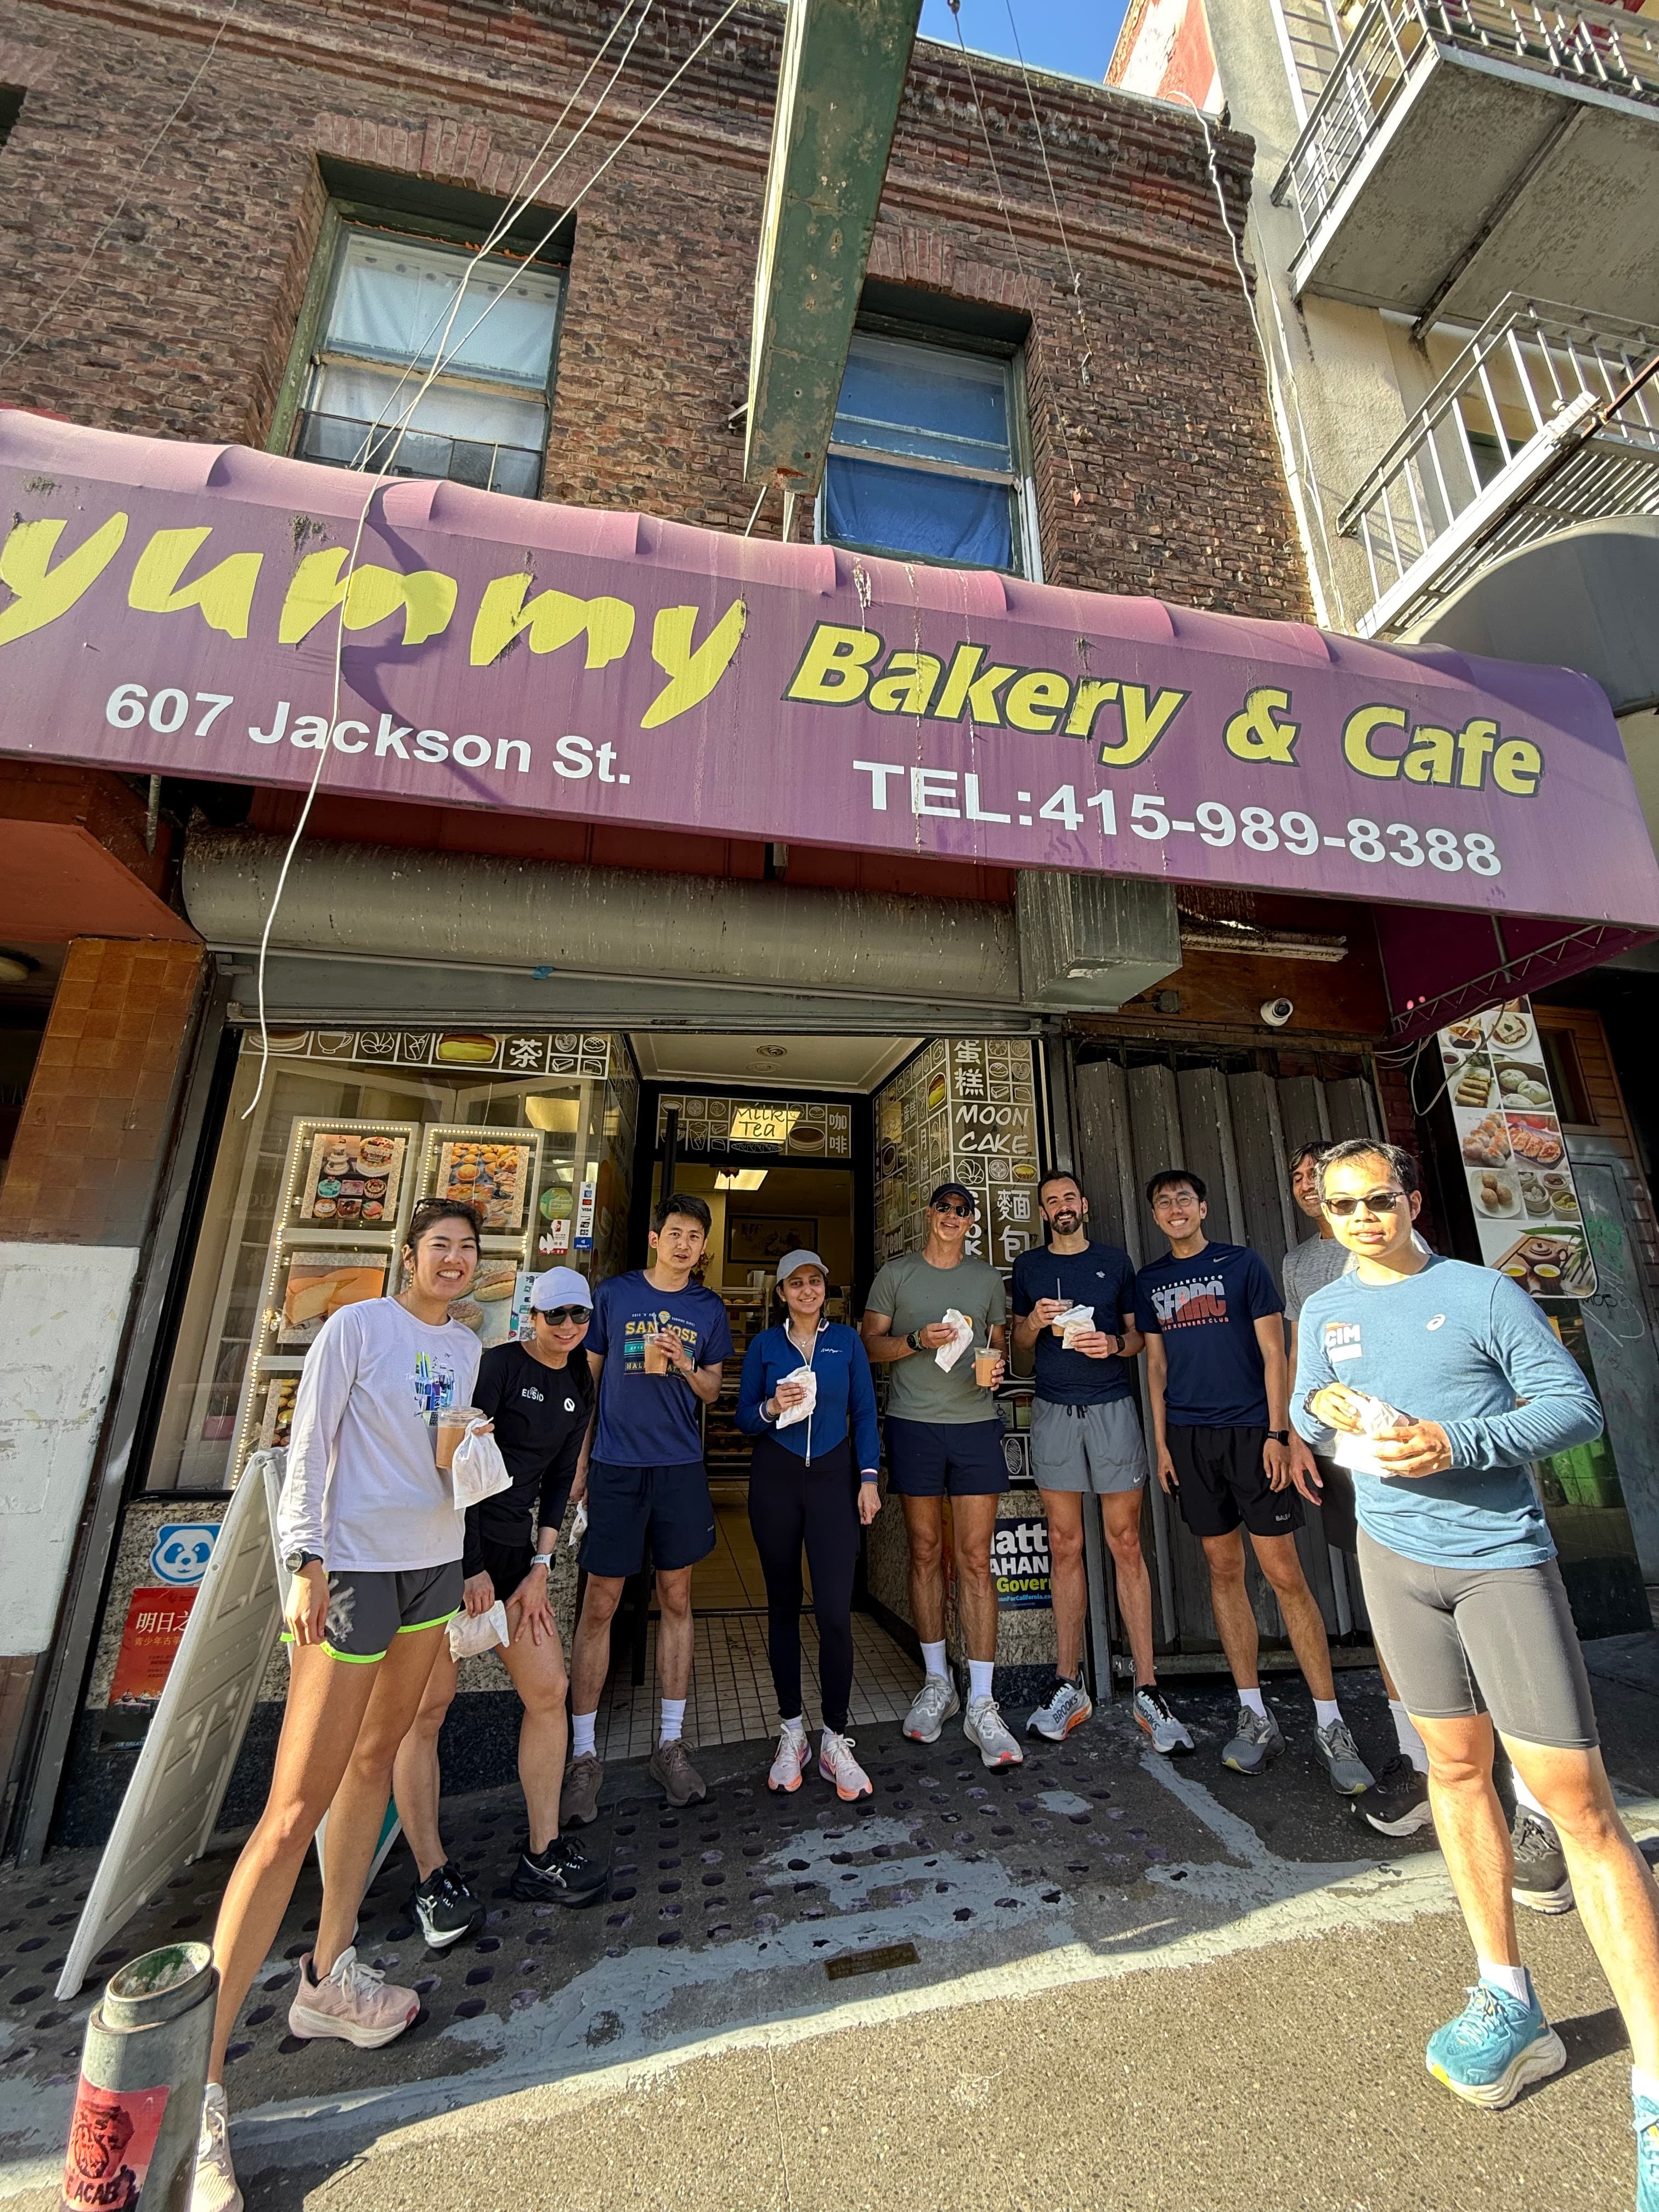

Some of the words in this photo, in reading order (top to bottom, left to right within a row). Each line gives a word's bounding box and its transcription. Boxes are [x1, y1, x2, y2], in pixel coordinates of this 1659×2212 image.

[0, 511, 747, 729] yummy
[781, 620, 1191, 769] Bakery
[1223, 686, 1301, 767] &
[1341, 703, 1544, 798] Cafe
[106, 683, 234, 737] 607
[249, 701, 532, 773] Jackson
[552, 735, 631, 785] St.
[853, 761, 1501, 876] TEL:415-989-8388
[509, 1038, 543, 1068] 茶
[953, 1040, 984, 1097] 蛋糕
[732, 1102, 785, 1122] Milk
[955, 1104, 1029, 1126] MOON
[738, 1121, 775, 1137] Tea
[829, 1112, 848, 1153] 咖啡
[958, 1133, 1029, 1154] CAKE
[997, 1189, 1031, 1262] 麵包
[1325, 1324, 1360, 1348] CIM
[626, 1362, 645, 1370] HAL
[990, 1523, 1048, 1555] att
[990, 1556, 1049, 1576] AHAN
[1052, 1694, 1078, 1724] BROOKS
